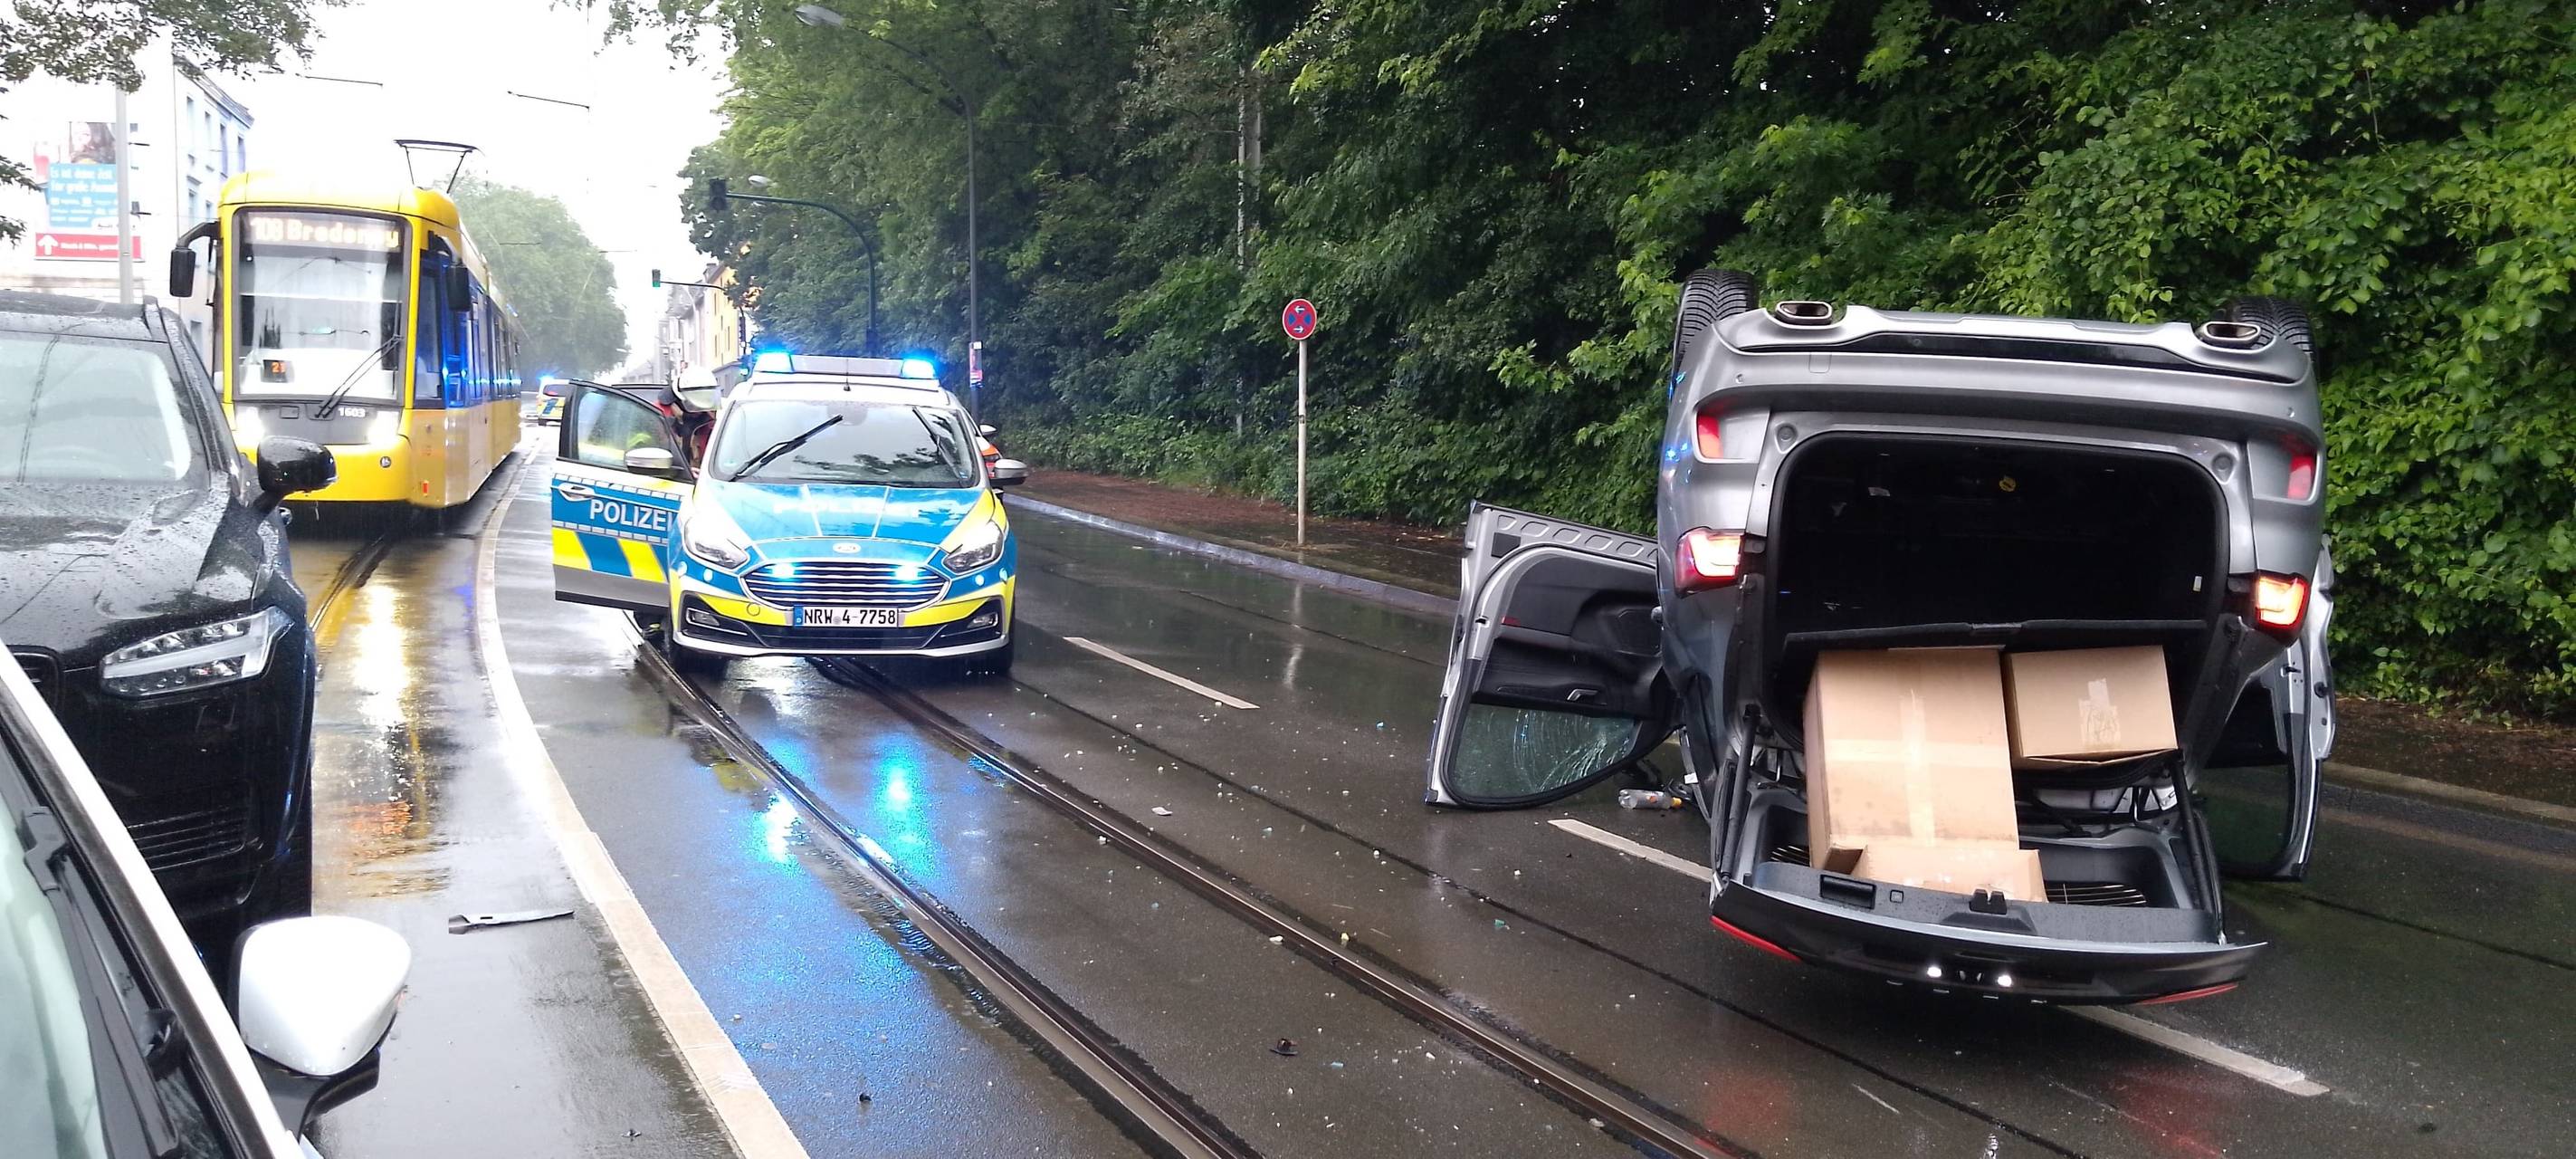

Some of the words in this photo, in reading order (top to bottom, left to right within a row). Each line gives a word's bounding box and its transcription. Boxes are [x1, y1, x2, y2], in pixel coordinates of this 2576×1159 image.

[250, 217, 282, 241] 108
[590, 499, 673, 532] POLIZEI
[805, 608, 833, 624] NRW
